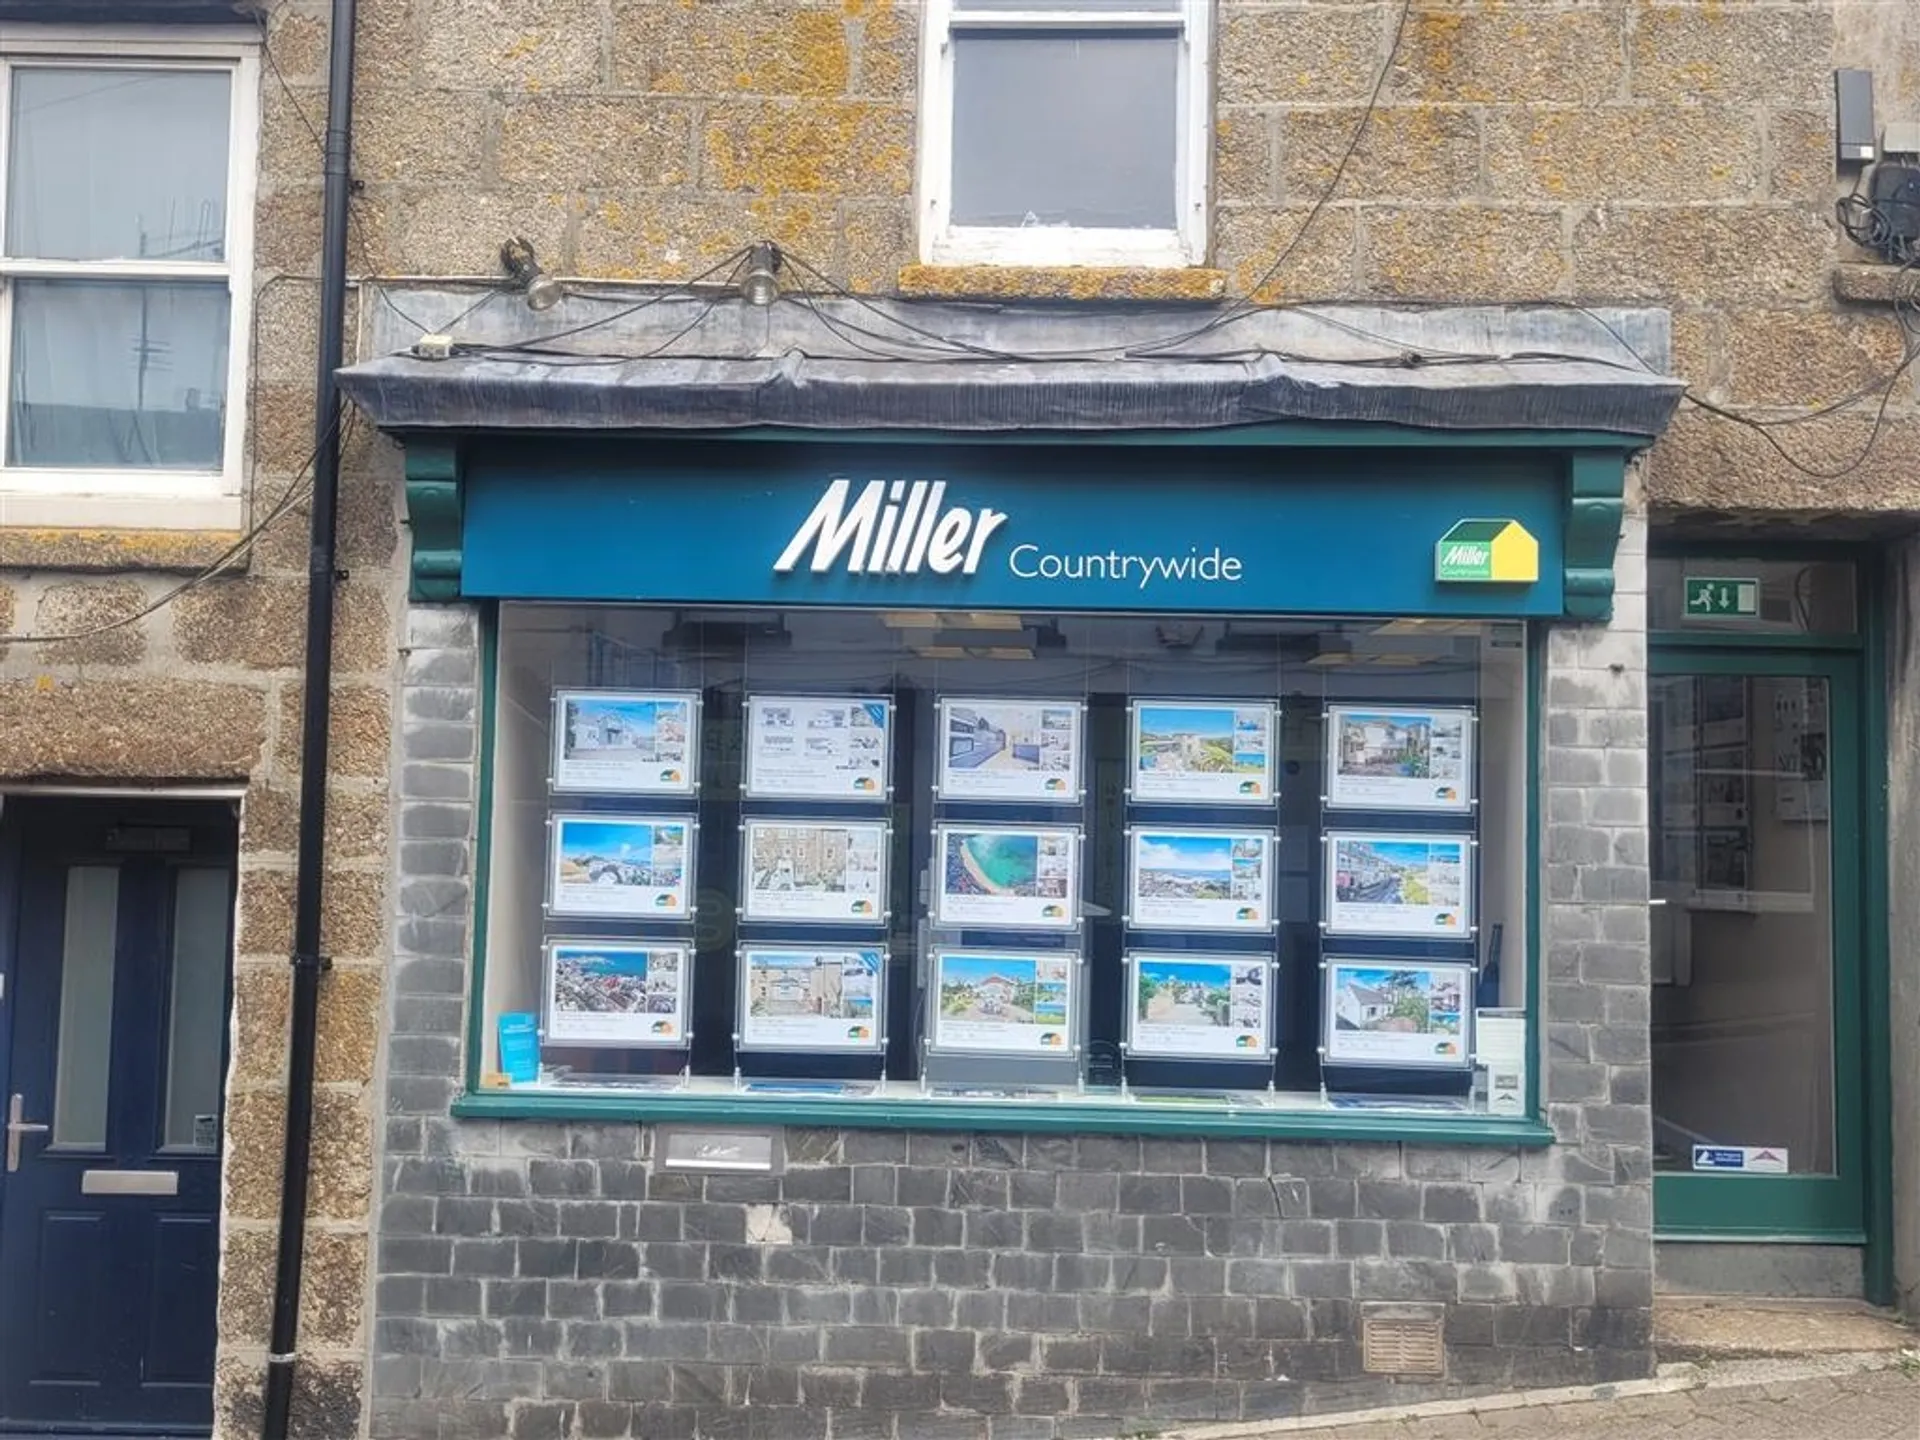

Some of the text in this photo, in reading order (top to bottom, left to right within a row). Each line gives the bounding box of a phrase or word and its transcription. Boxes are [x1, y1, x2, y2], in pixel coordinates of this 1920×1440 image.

[773, 479, 1243, 589] Miller Countrywide
[1442, 545, 1490, 566] Miller
